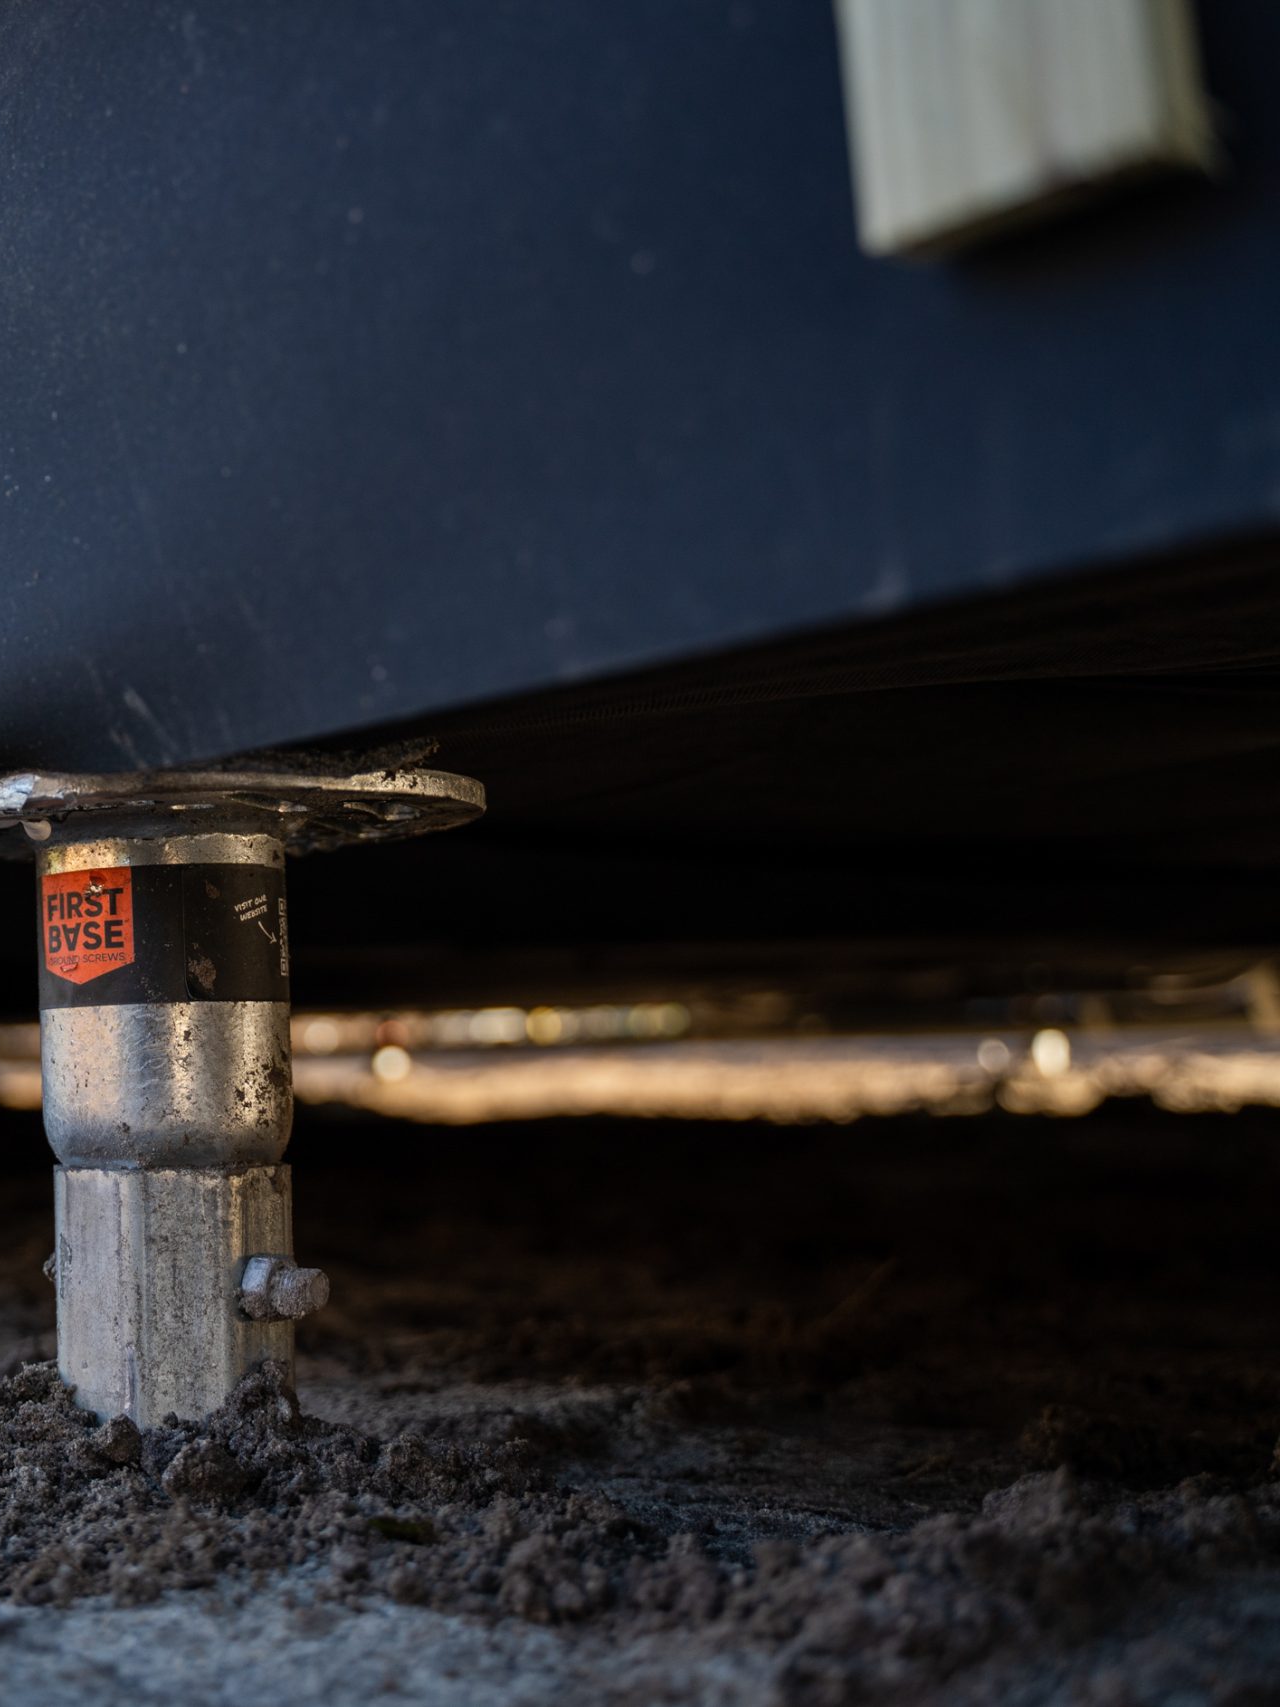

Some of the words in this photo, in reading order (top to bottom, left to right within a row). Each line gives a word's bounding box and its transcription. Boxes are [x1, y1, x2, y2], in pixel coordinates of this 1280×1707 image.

[47, 888, 124, 921] FIRST
[234, 899, 253, 912] VISIT
[254, 893, 268, 905] OUR
[239, 904, 268, 921] WEBSITE
[48, 920, 124, 953] BASE
[82, 951, 125, 962] SCREWS
